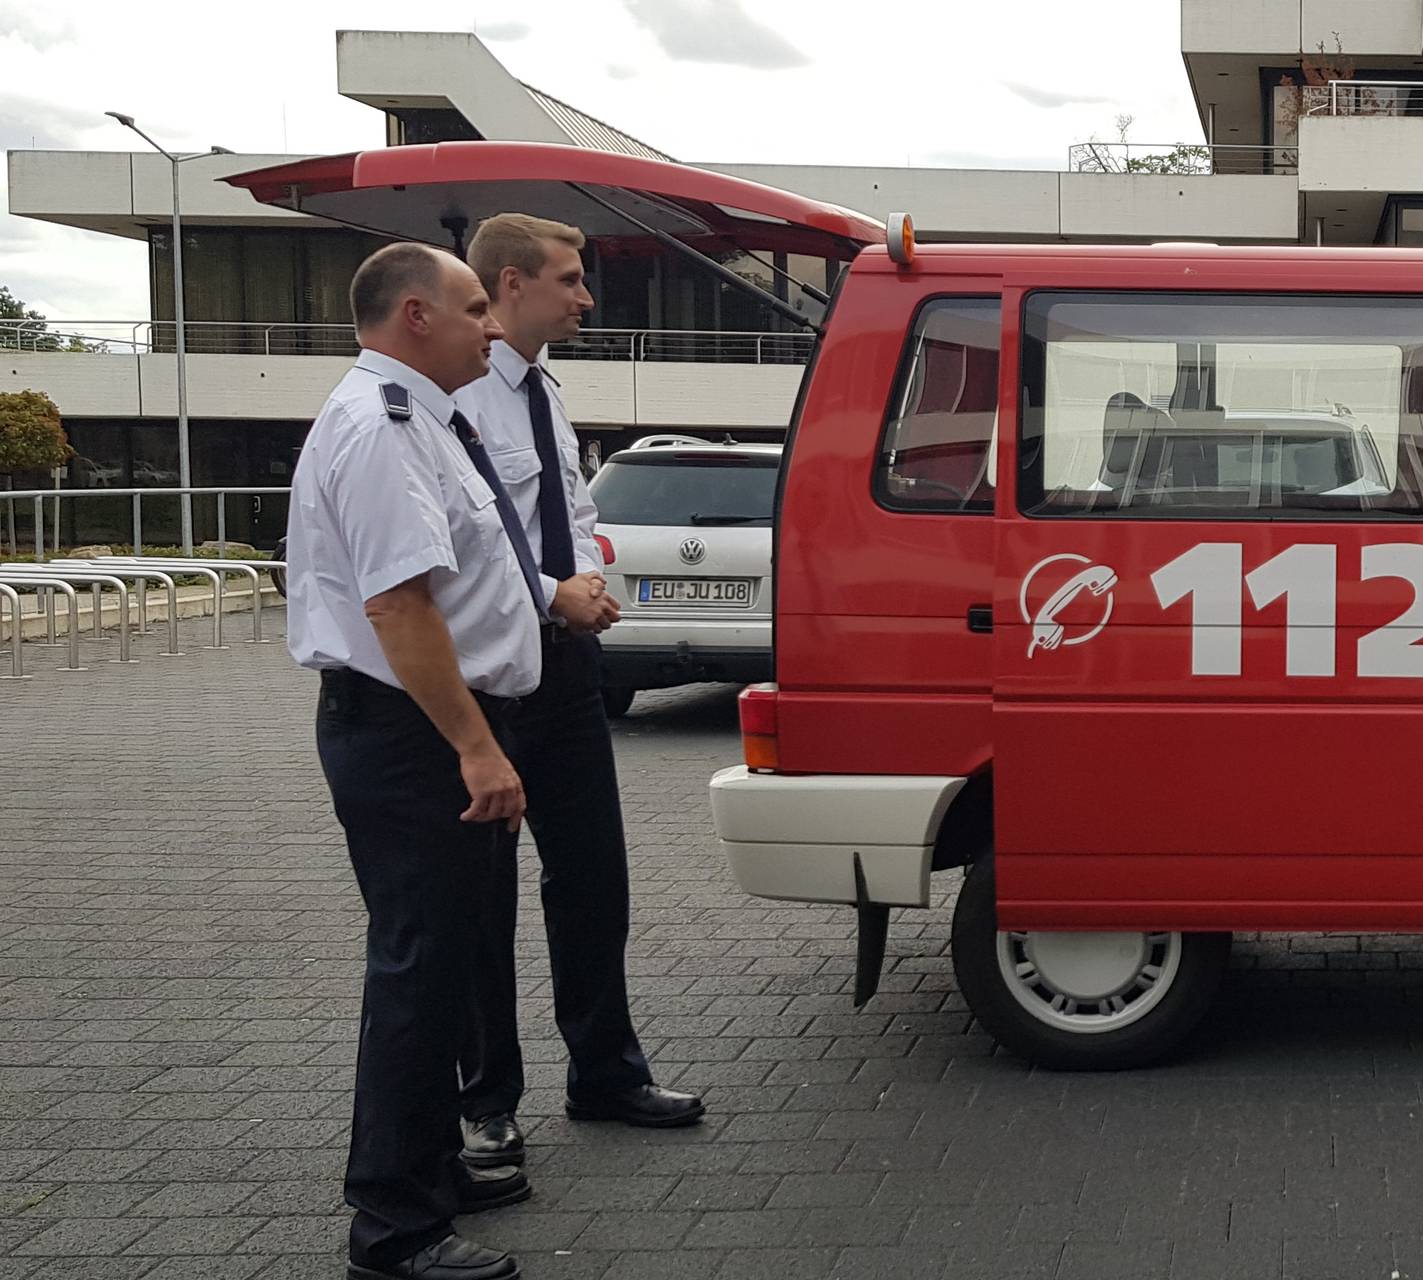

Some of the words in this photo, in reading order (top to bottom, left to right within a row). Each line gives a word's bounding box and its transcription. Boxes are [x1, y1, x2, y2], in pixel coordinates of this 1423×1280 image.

[651, 582, 675, 599] EU
[686, 583, 710, 599] JU
[714, 584, 747, 600] 108
